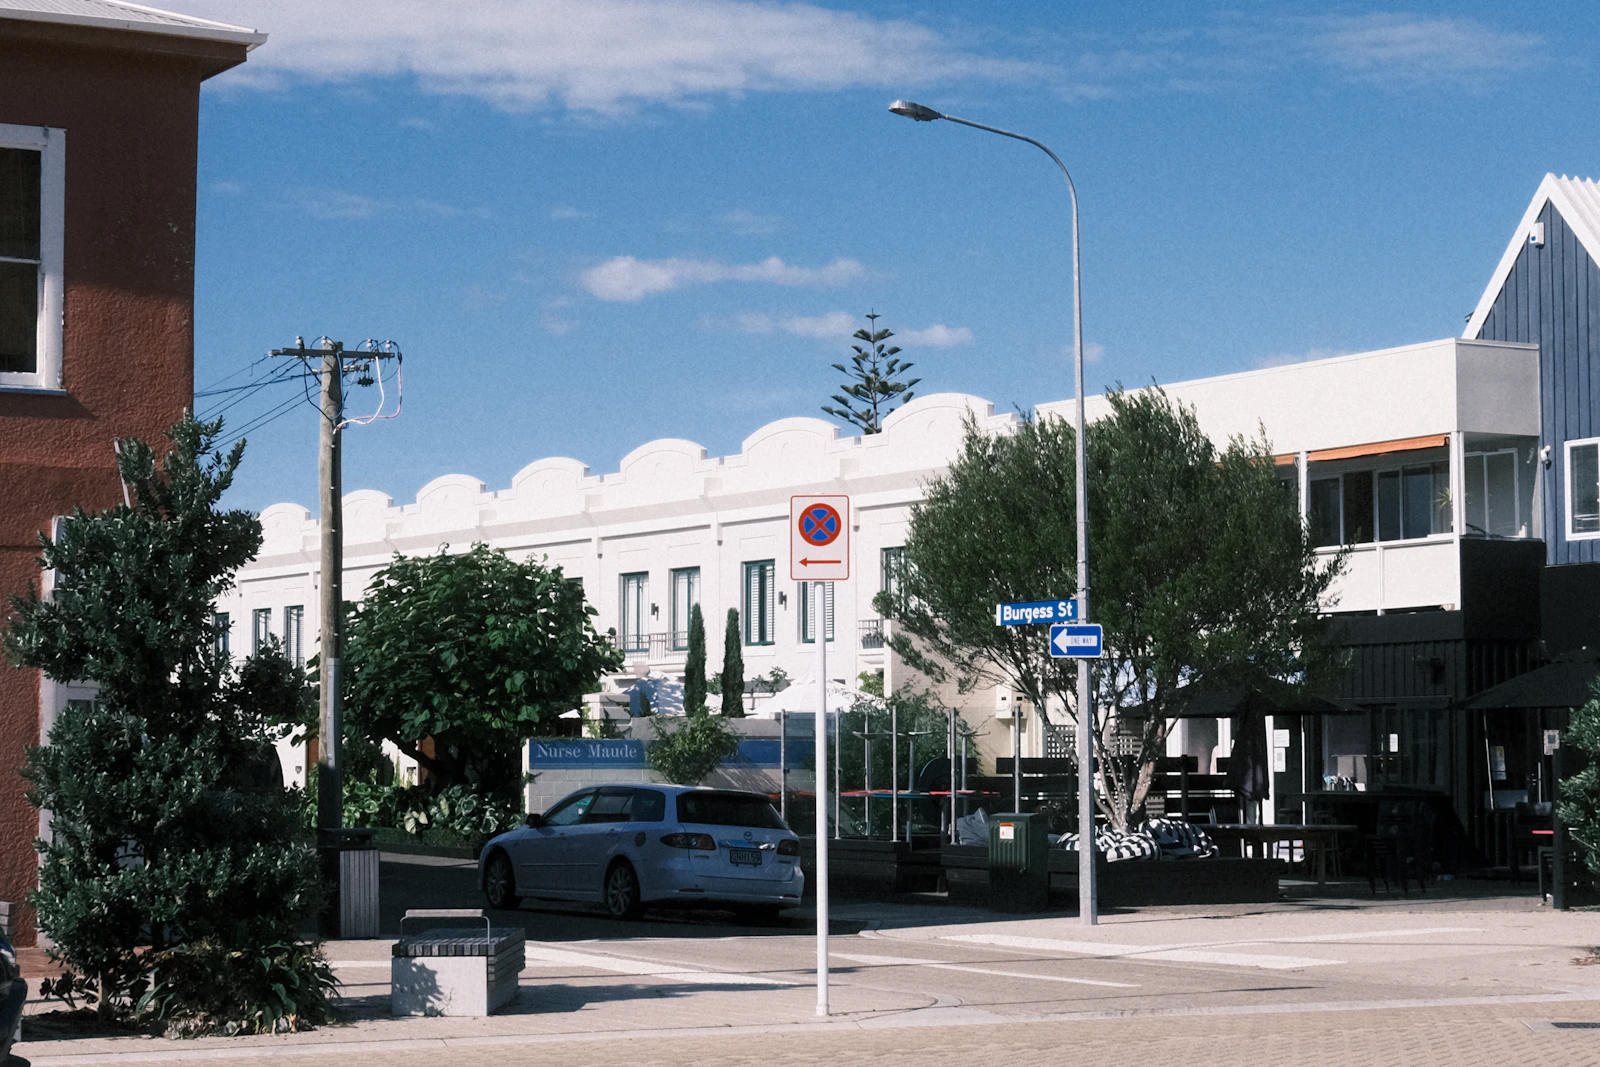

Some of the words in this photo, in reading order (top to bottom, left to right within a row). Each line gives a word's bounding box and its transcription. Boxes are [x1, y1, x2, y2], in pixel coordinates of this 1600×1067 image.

[1003, 605, 1053, 624] Burgess
[1058, 601, 1073, 617] St
[1070, 637, 1081, 645] ONE
[1082, 636, 1092, 645] WAY
[536, 743, 581, 758] Nurse
[588, 743, 637, 758] Maude
[731, 851, 761, 863] GNH159
